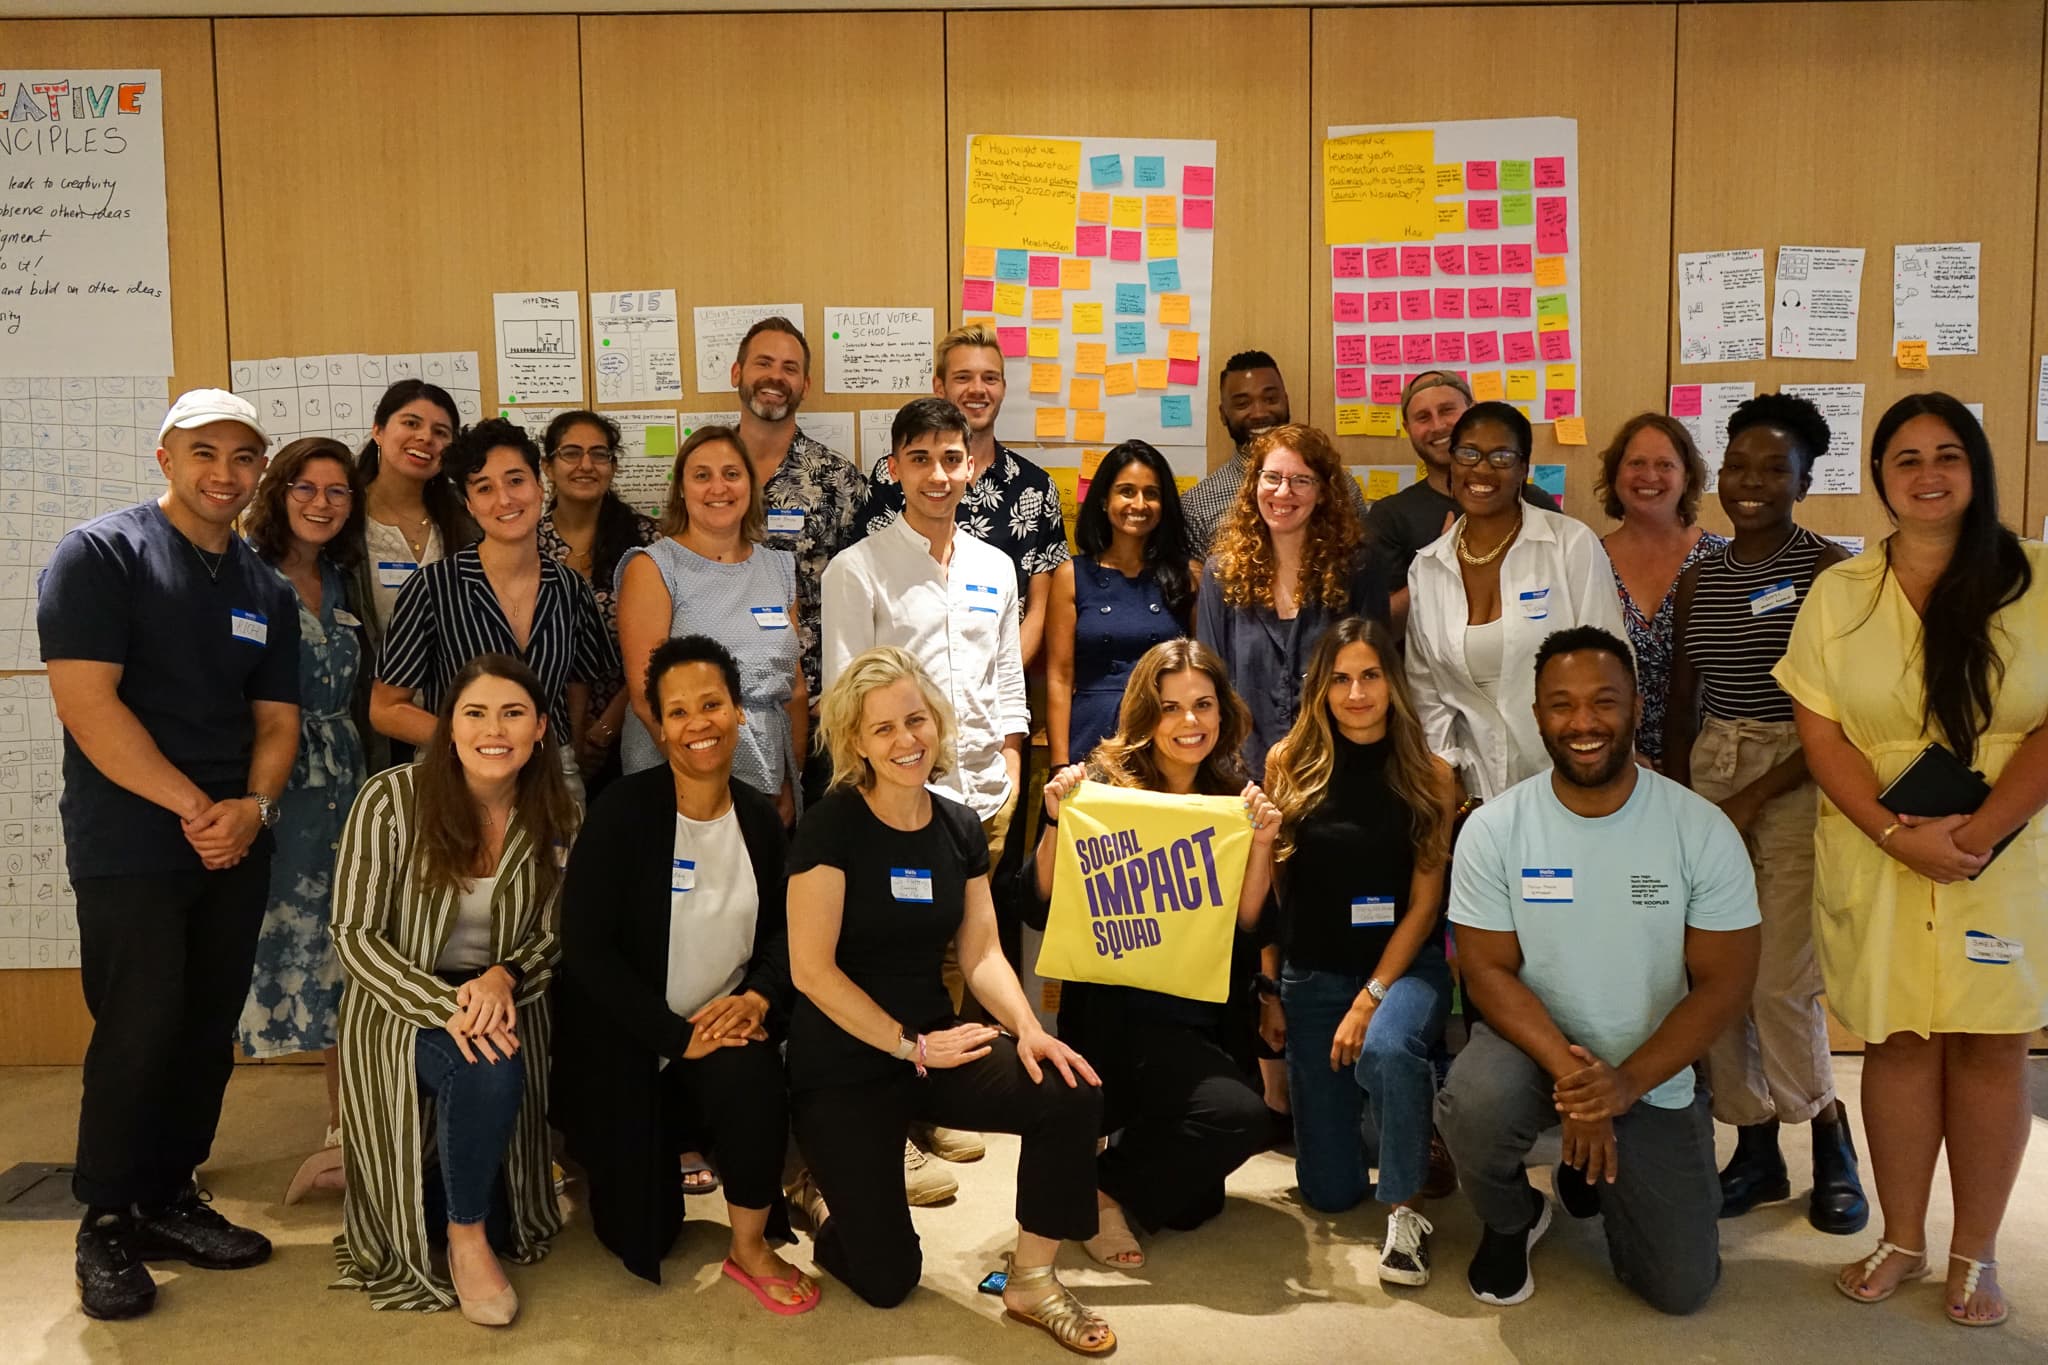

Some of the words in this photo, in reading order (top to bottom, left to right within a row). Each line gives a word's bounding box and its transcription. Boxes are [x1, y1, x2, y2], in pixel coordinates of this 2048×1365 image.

[988, 141, 1009, 155] How
[1011, 144, 1037, 158] might
[1040, 145, 1056, 154] we
[1367, 149, 1394, 165] youth
[43, 177, 54, 189] to
[1025, 187, 1051, 197] 2020
[0, 229, 52, 251] gment
[1, 285, 23, 295] and
[88, 280, 120, 294] other
[126, 280, 162, 298] ideas
[834, 311, 880, 329] TALENT
[887, 310, 923, 324] VOTER
[852, 326, 899, 338] SCHOOL
[1075, 829, 1143, 876] SOCIAL
[1084, 826, 1224, 918] IMPACT
[1092, 917, 1162, 960] SQUAD
